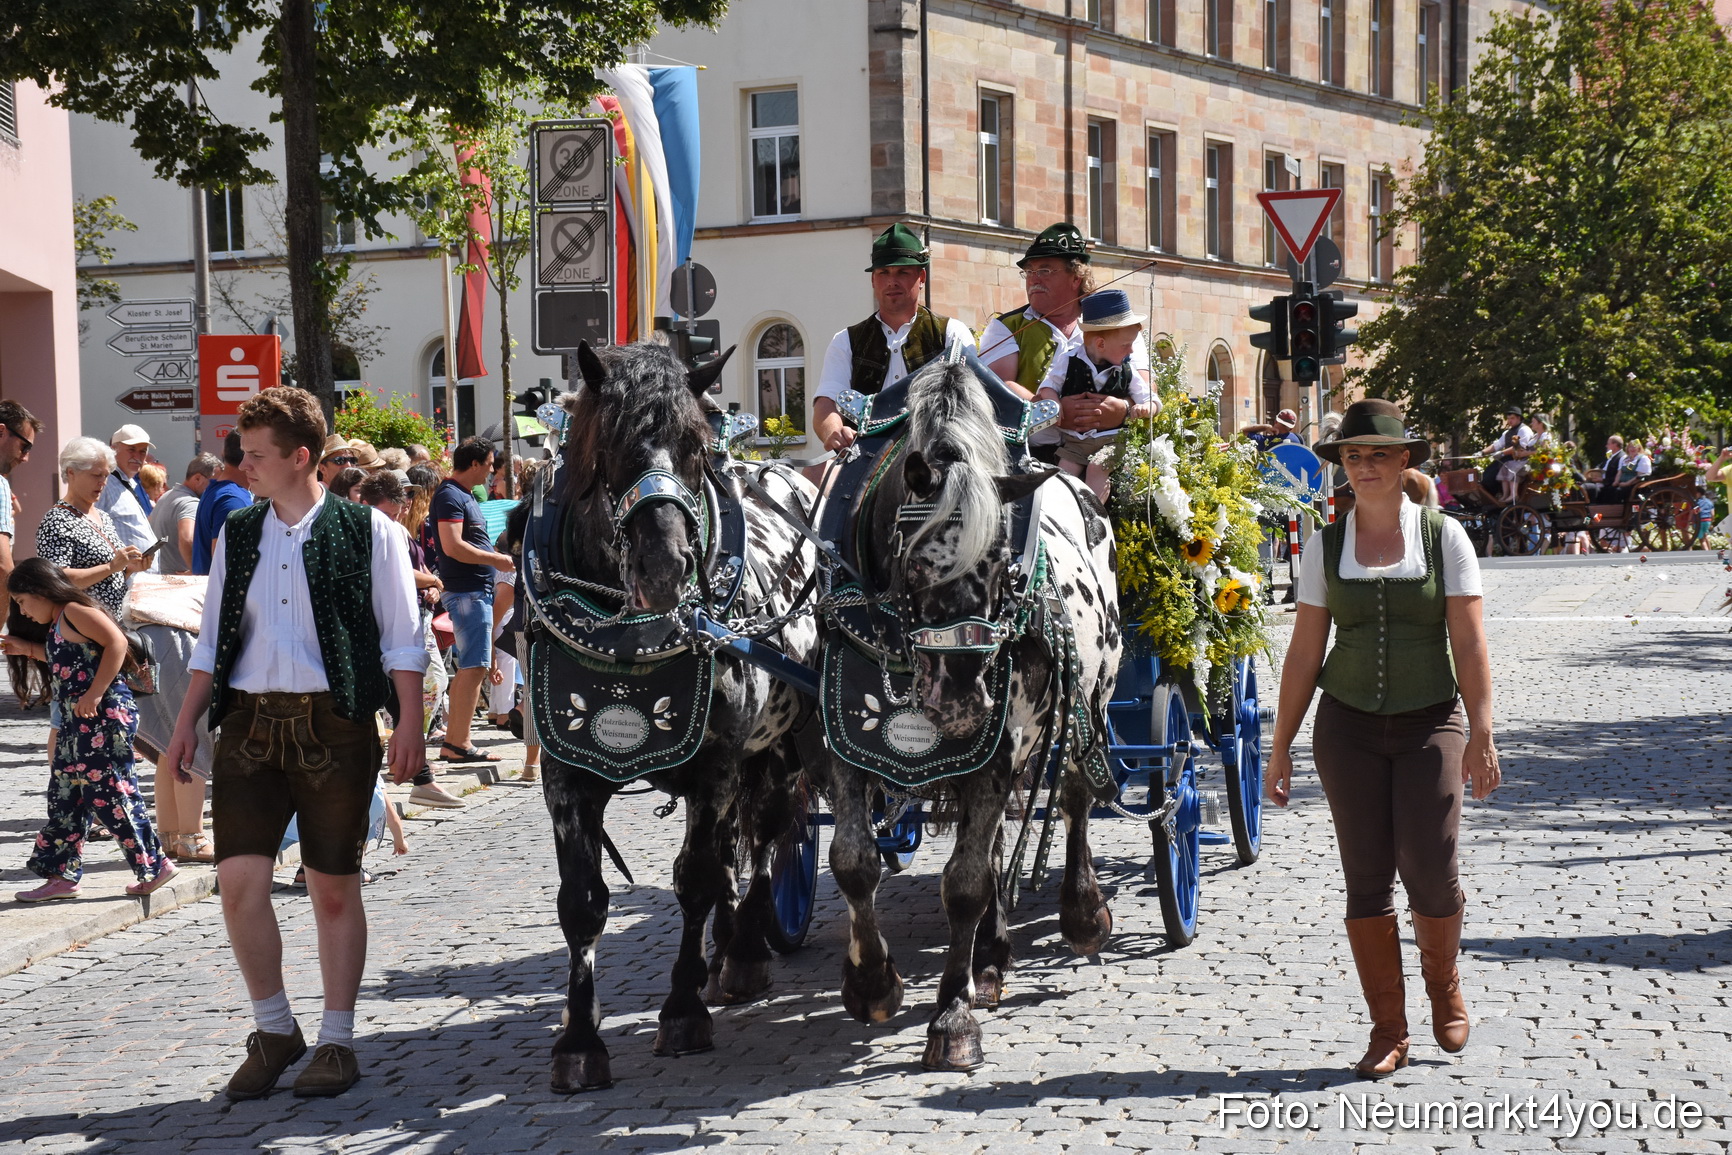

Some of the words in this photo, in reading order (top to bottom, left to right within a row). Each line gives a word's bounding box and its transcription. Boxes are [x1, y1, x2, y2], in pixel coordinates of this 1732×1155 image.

[555, 185, 589, 198] ZONE
[557, 267, 590, 280] ZONE
[161, 333, 188, 341] Schulen
[154, 361, 189, 379] AOK
[151, 392, 170, 400] Walking
[215, 429, 229, 438] LB
[601, 718, 640, 727] Holzrückerei
[893, 722, 933, 731] Holzrückerei
[602, 729, 638, 739] Weismann
[893, 733, 930, 743] Weismann
